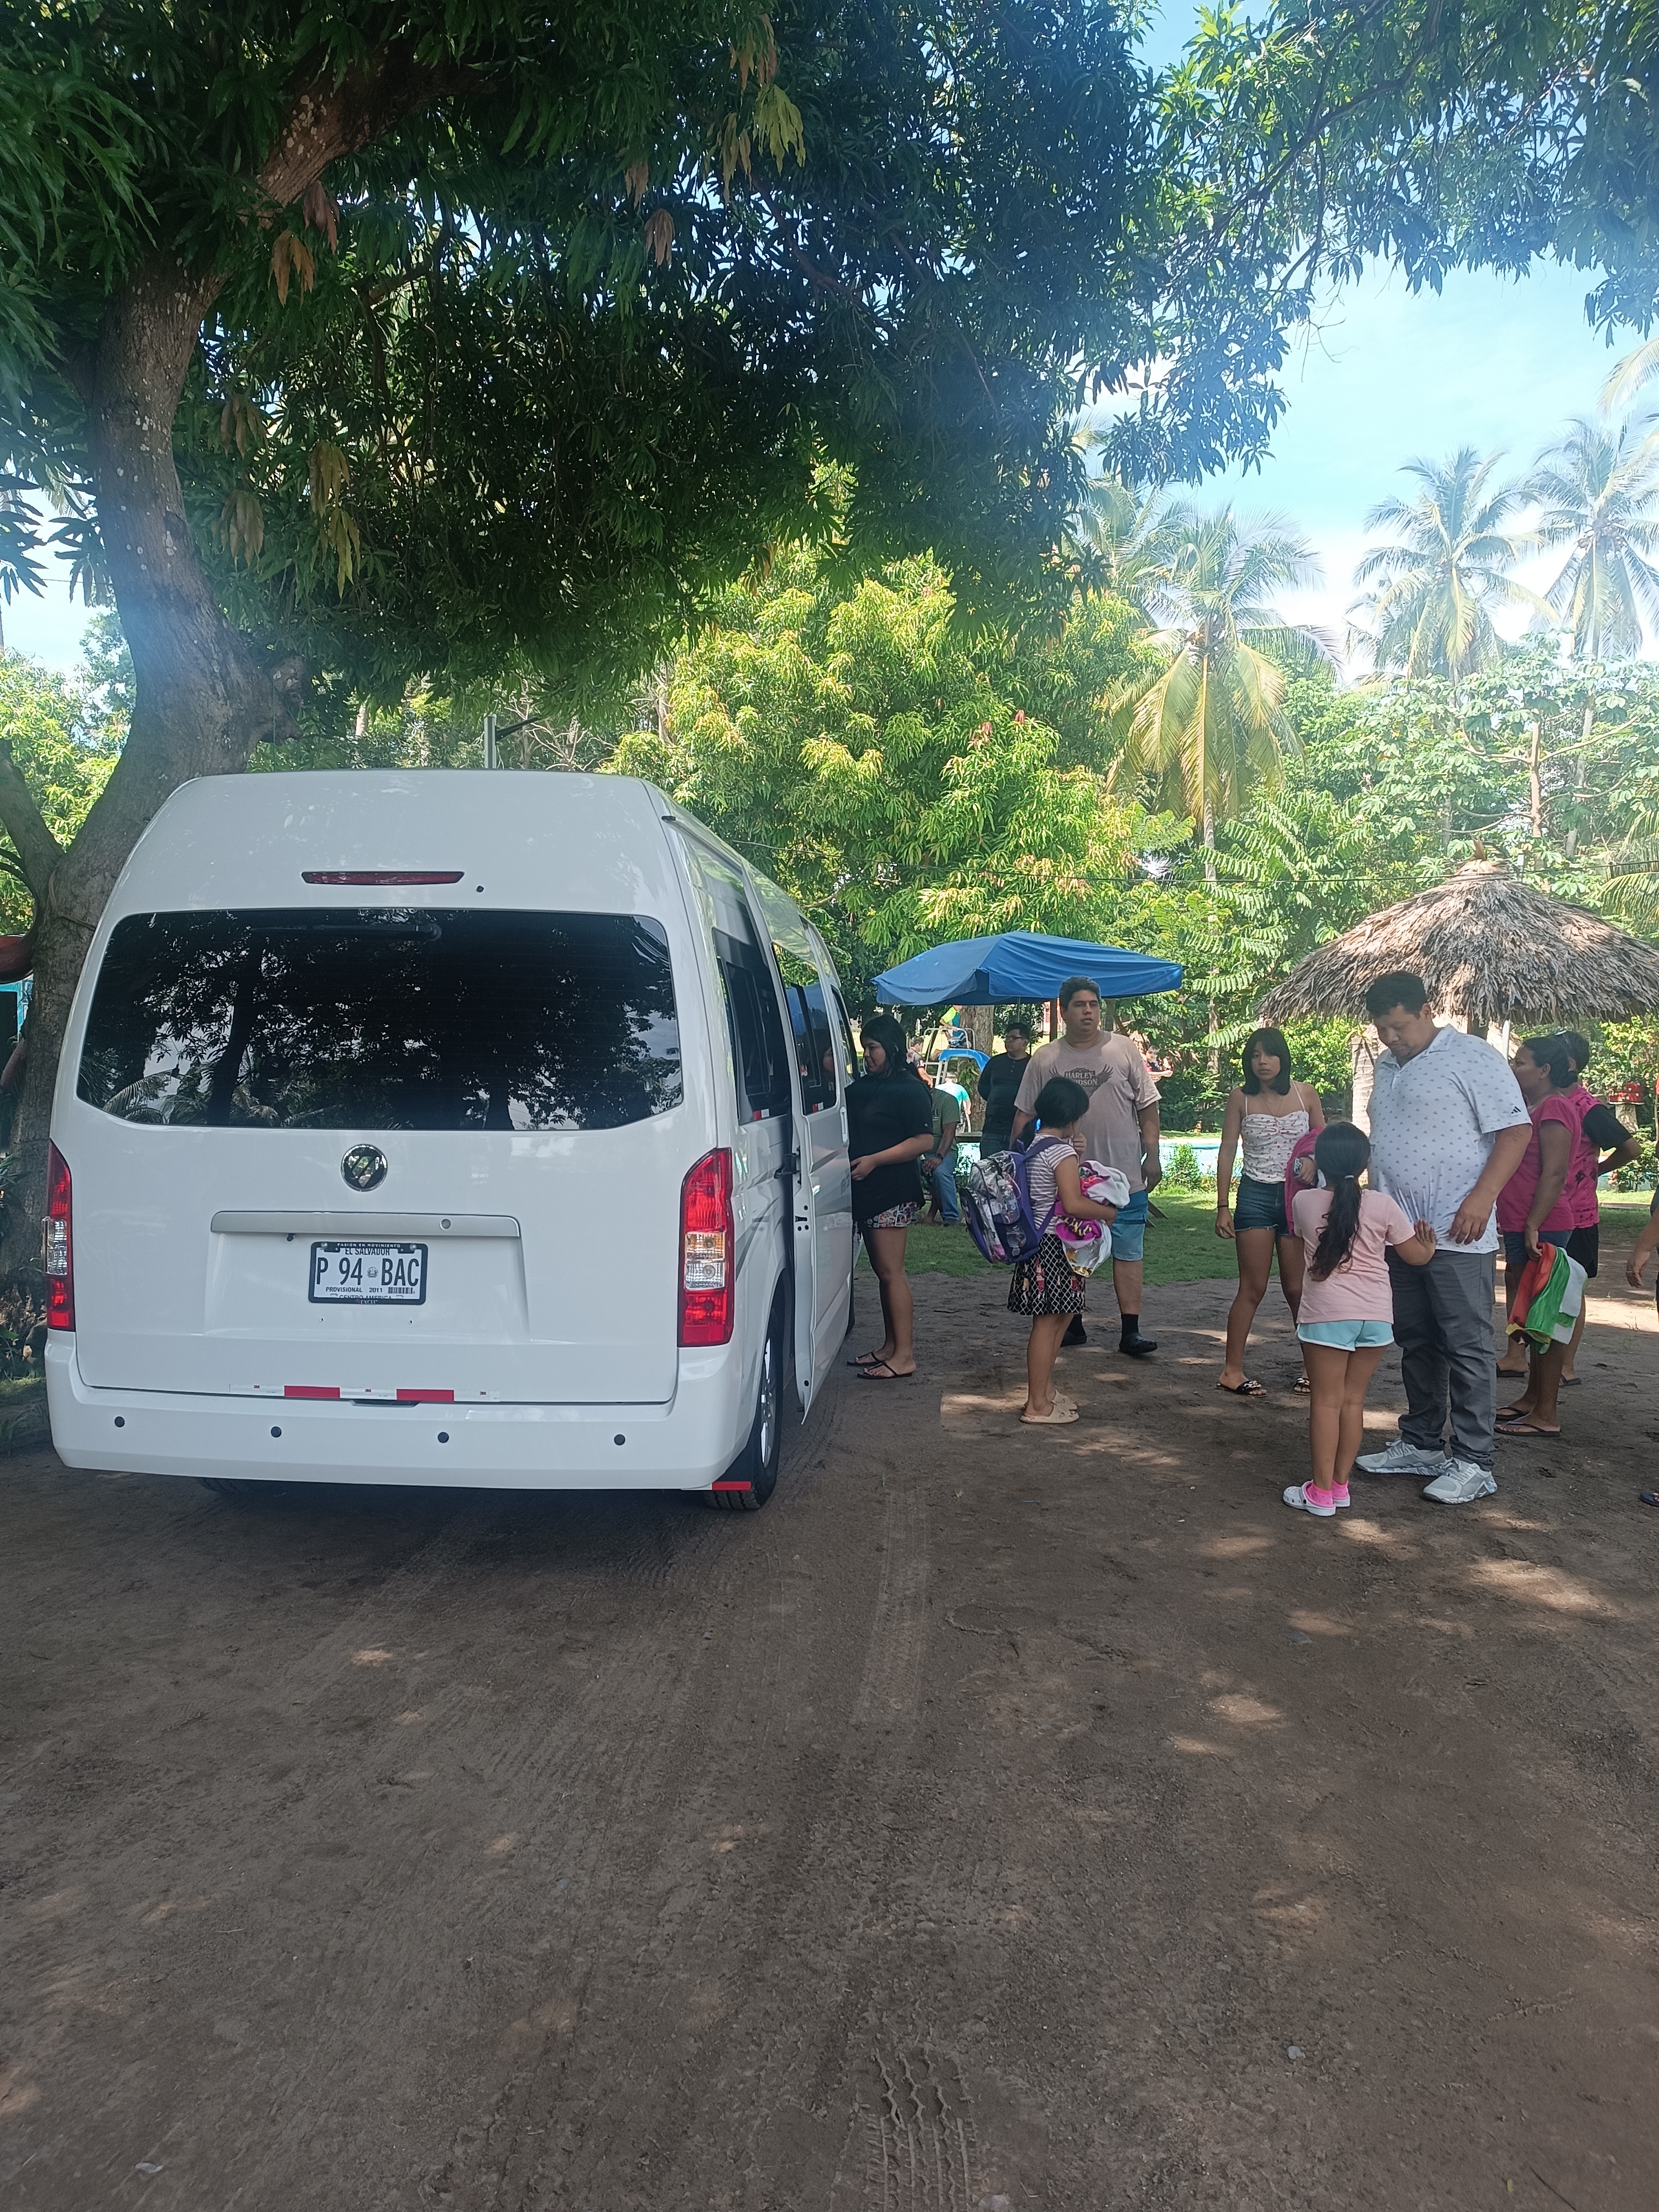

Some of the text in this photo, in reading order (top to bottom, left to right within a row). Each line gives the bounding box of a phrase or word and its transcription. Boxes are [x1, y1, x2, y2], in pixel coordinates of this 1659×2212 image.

[316, 1257, 419, 1286] P 94 BAC
